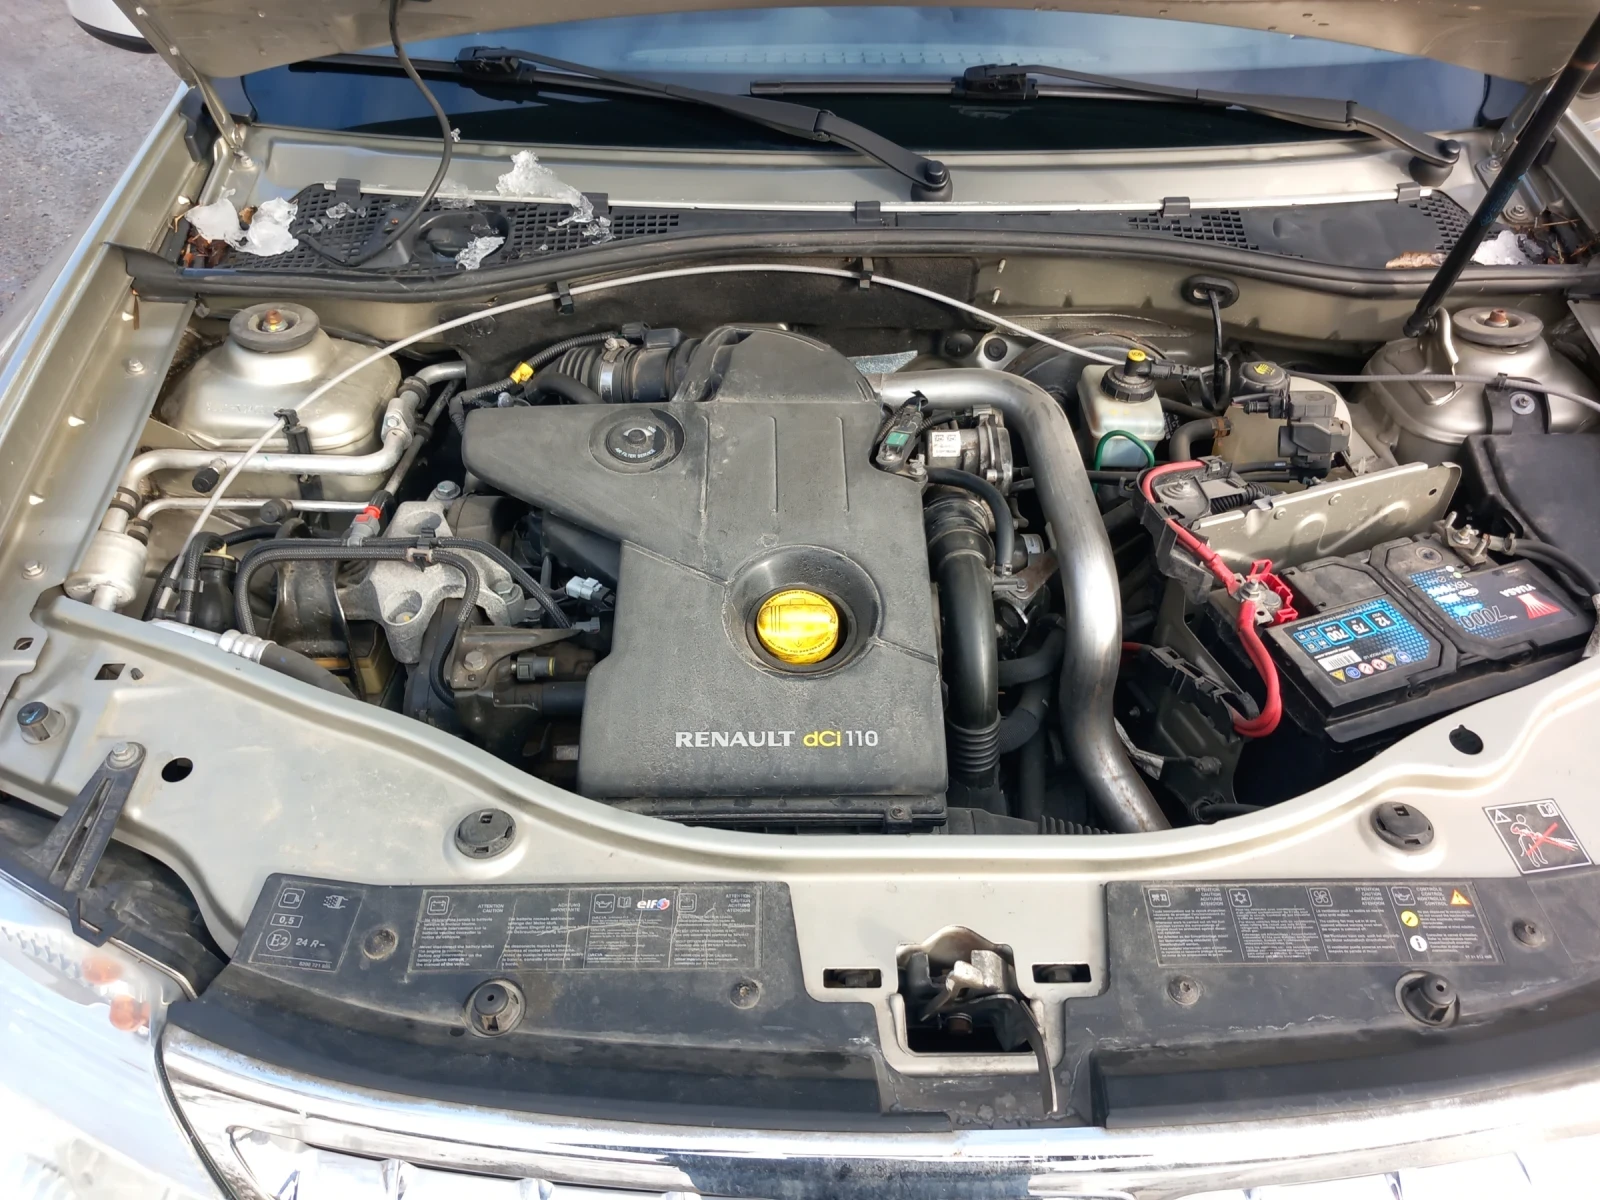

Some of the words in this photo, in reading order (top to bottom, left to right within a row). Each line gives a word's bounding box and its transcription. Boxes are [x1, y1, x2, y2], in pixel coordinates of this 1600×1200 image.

[637, 448, 656, 458] SERVICE
[1498, 583, 1537, 598] YUASA
[1376, 616, 1391, 628] 12
[1460, 605, 1509, 630] 7000
[1355, 621, 1370, 634] 75
[1328, 628, 1349, 642] 700
[675, 731, 795, 748] RENAULT
[803, 730, 841, 747] dCi
[846, 730, 878, 747] 110
[637, 899, 658, 908] elf
[279, 916, 295, 925] 0,5
[269, 933, 288, 947] E2
[296, 938, 308, 946] 24
